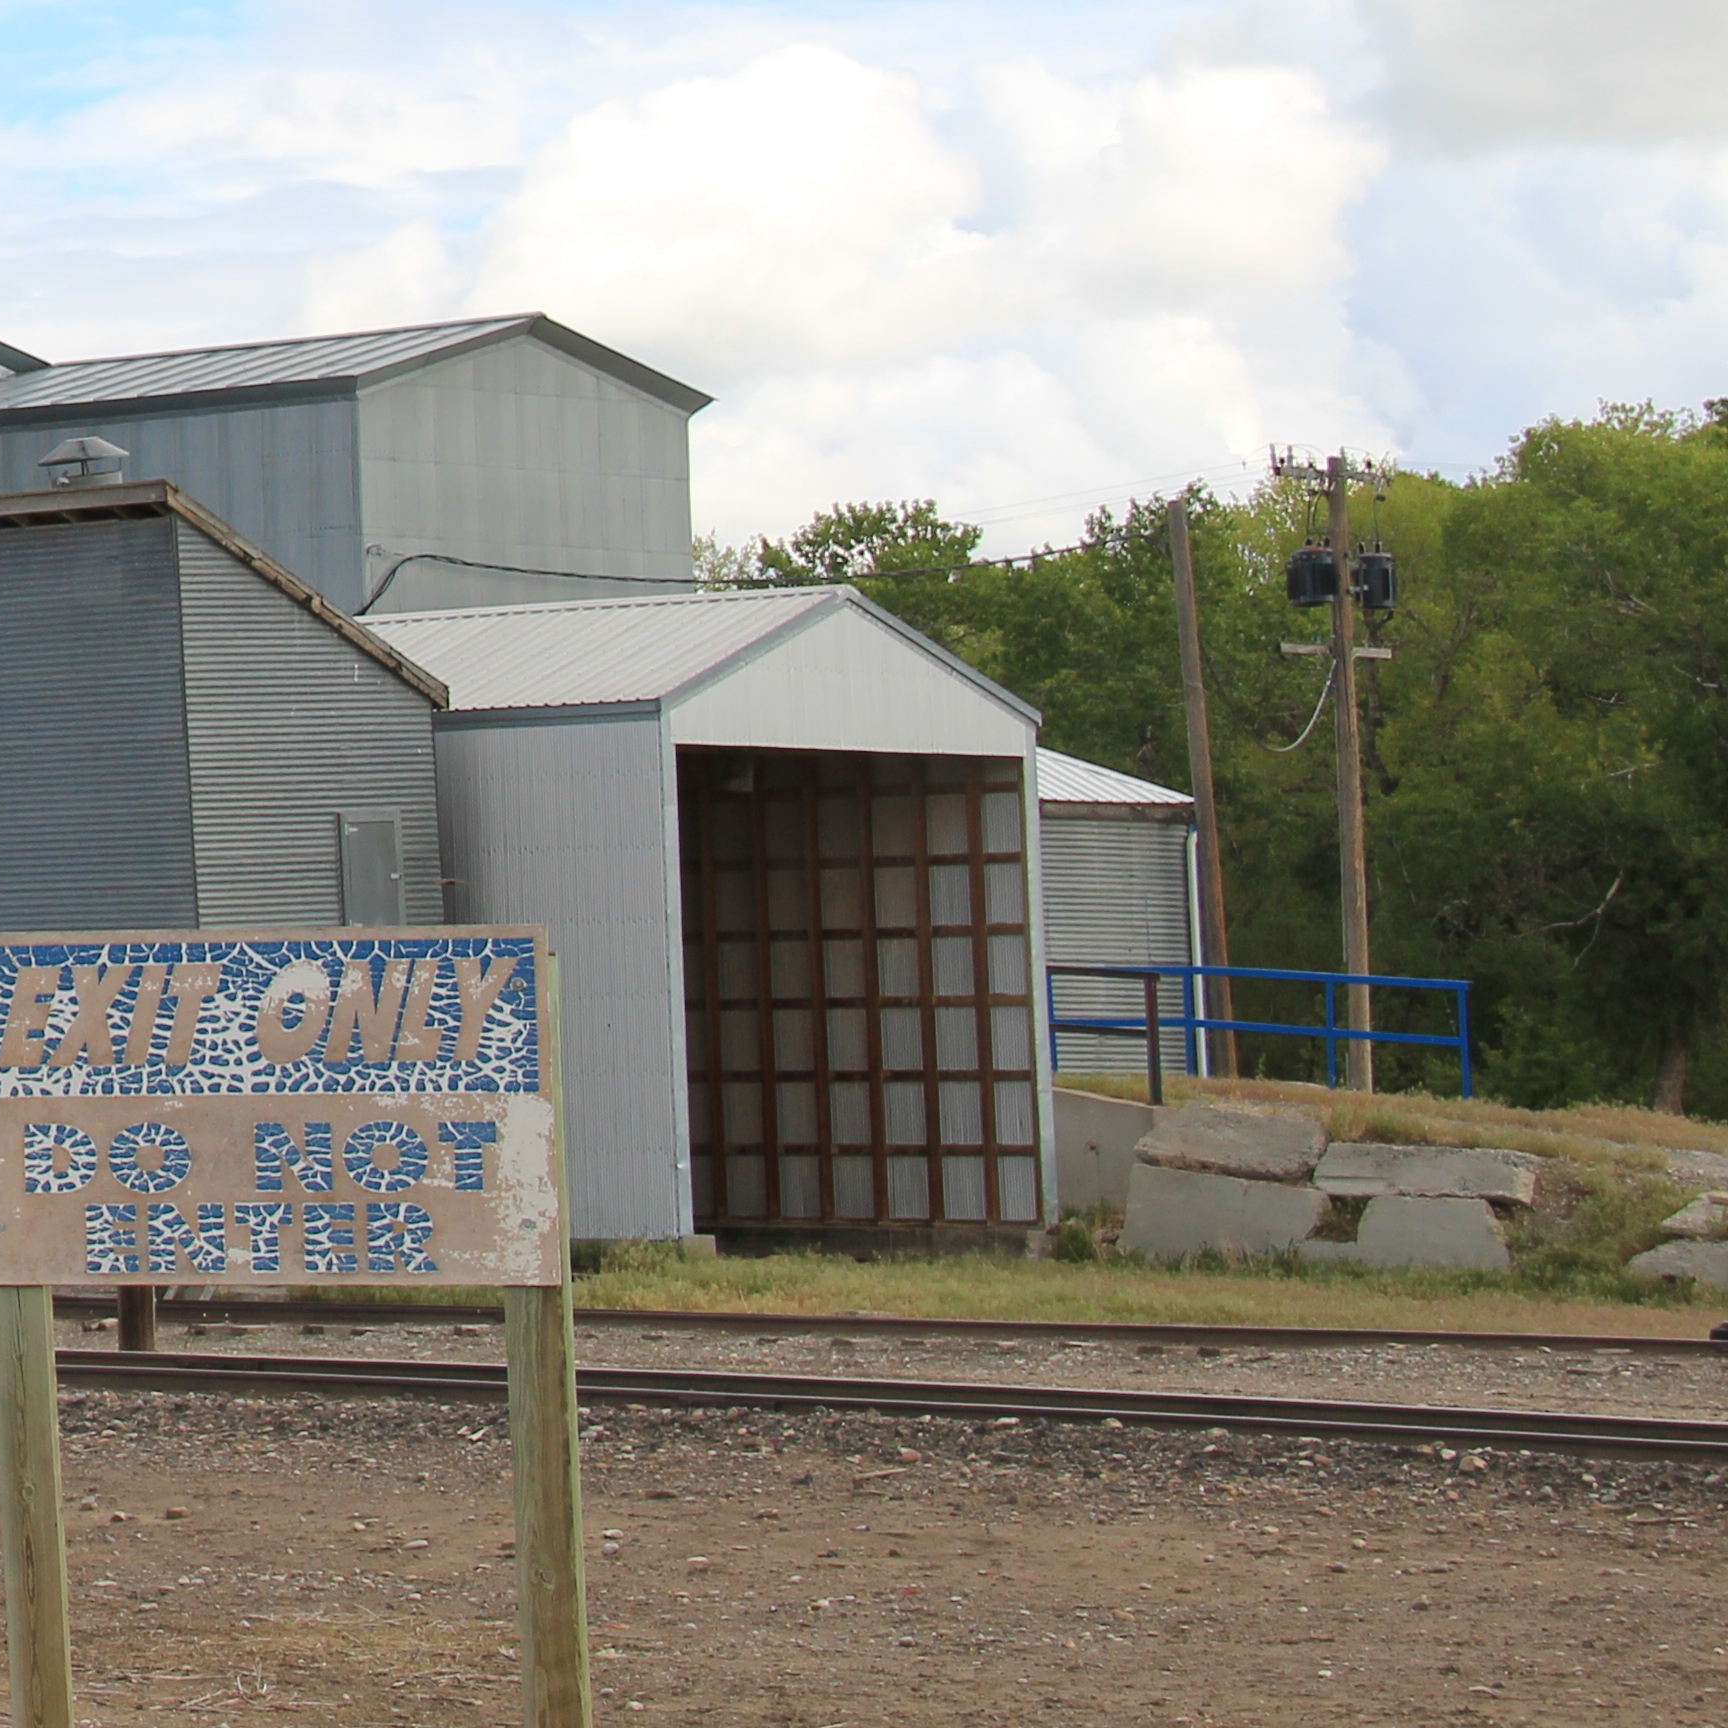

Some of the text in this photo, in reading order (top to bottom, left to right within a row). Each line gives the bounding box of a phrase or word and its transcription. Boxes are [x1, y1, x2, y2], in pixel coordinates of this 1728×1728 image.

[255, 956, 518, 1066] ONLY
[24, 1120, 497, 1194] DO NOT
[85, 1201, 440, 1274] ENTER
